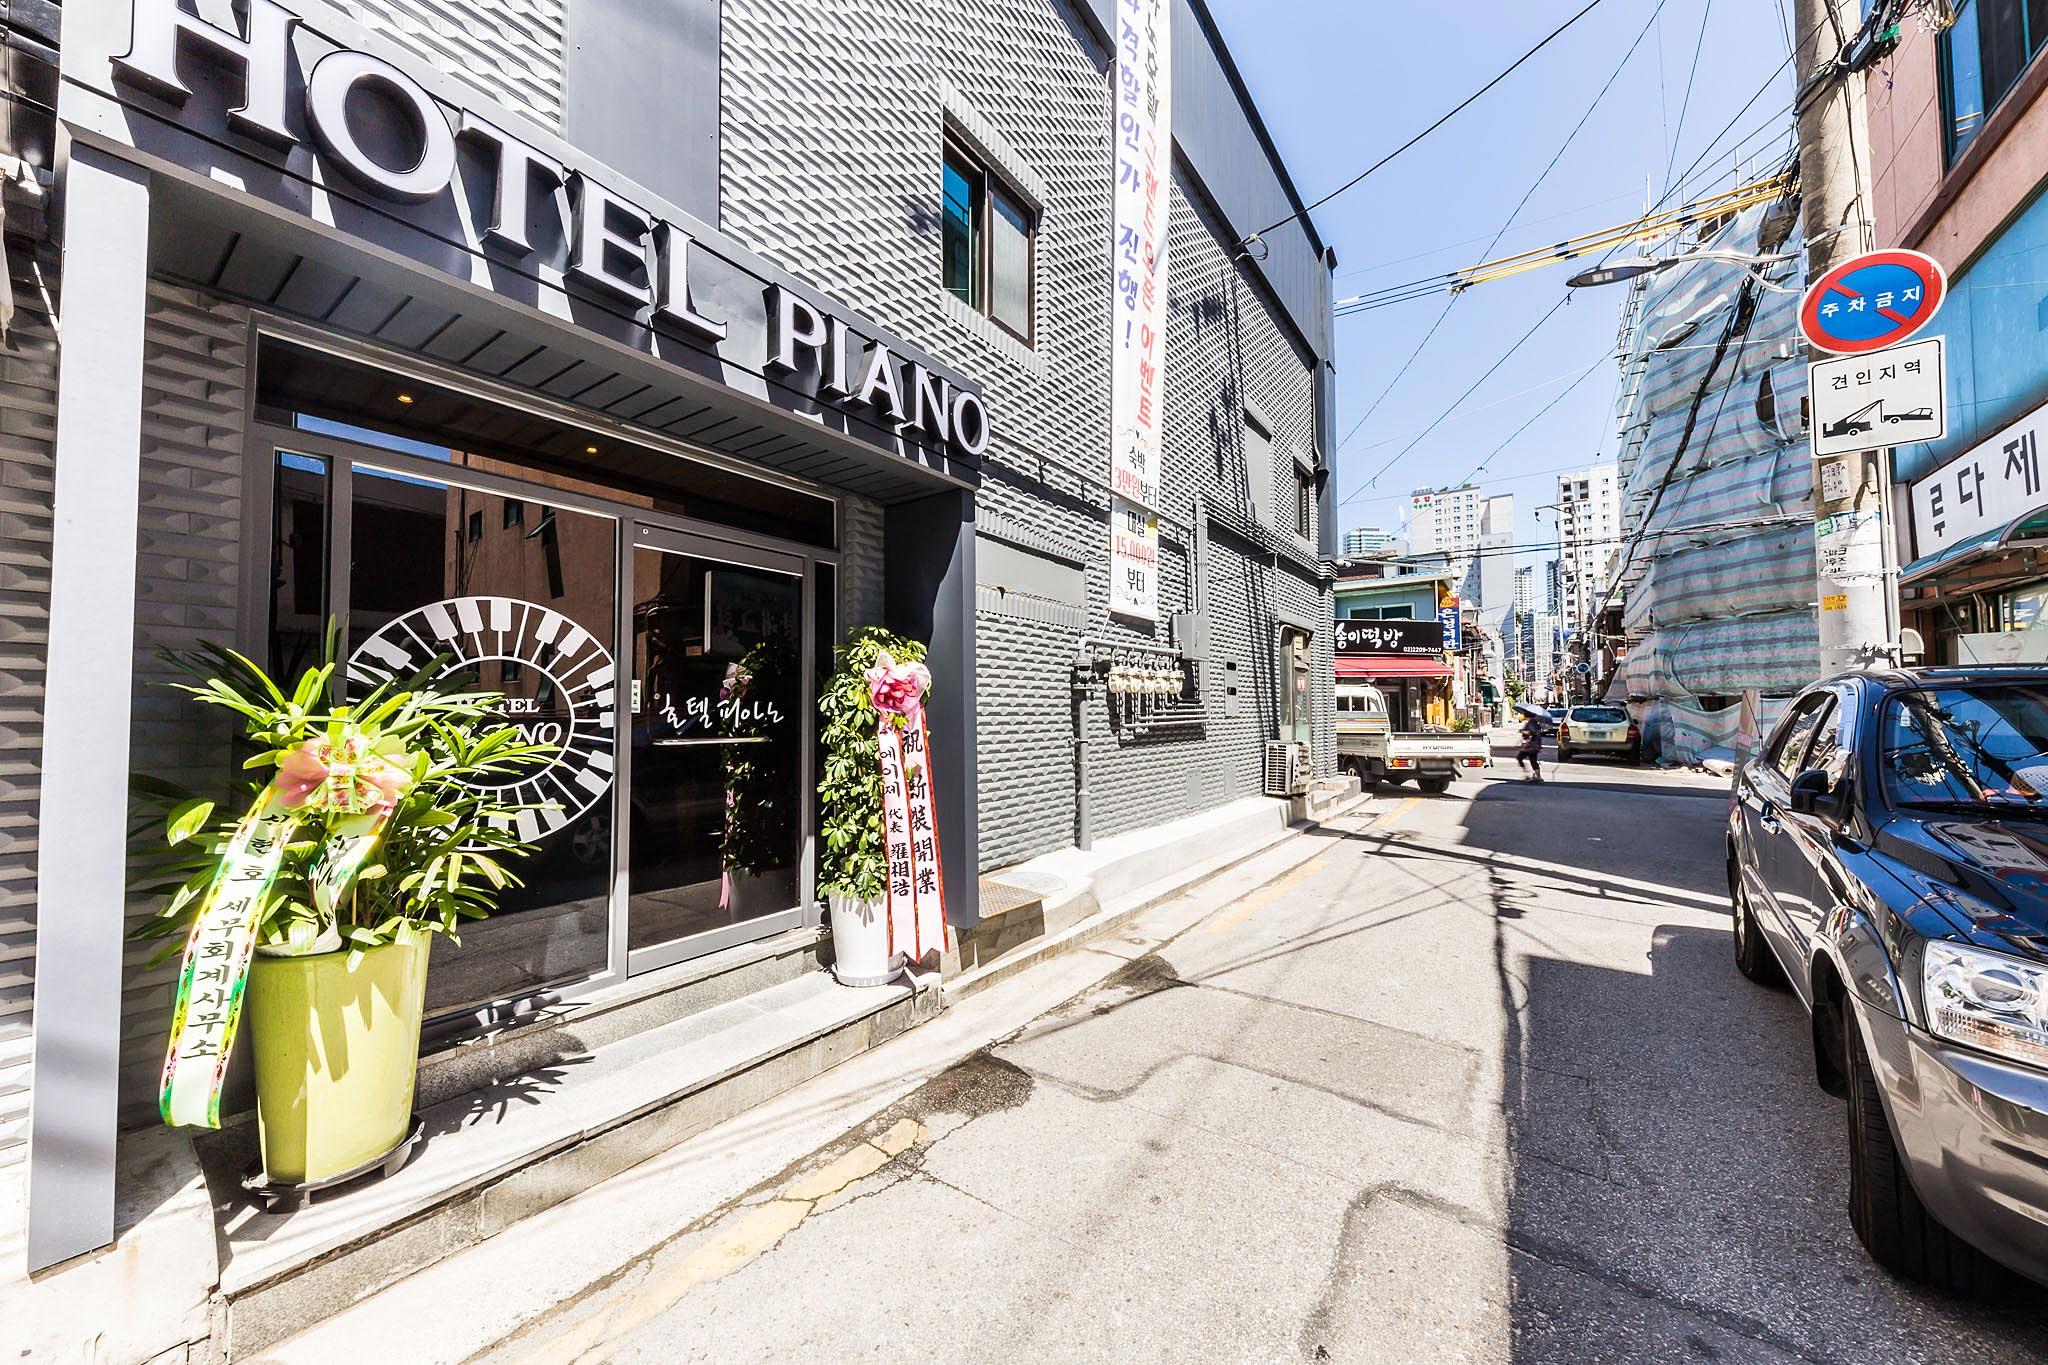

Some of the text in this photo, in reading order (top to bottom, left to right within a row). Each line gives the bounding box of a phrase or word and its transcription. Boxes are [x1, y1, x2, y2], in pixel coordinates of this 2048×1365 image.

[109, 0, 990, 455] HOTEL PIANO
[1821, 285, 1922, 318] 주차금지
[1137, 323, 1156, 430] 이벤트
[1831, 359, 1923, 391] 견인지역
[1128, 446, 1146, 474] 숙박
[1128, 511, 1146, 538] 대실
[1127, 566, 1145, 593] 부터
[456, 698, 541, 713] HTEL
[659, 693, 785, 729] 호텔 피아노
[902, 728, 924, 755] 祝
[888, 808, 904, 833] 代表
[180, 896, 253, 1060] 세무회계사무소
